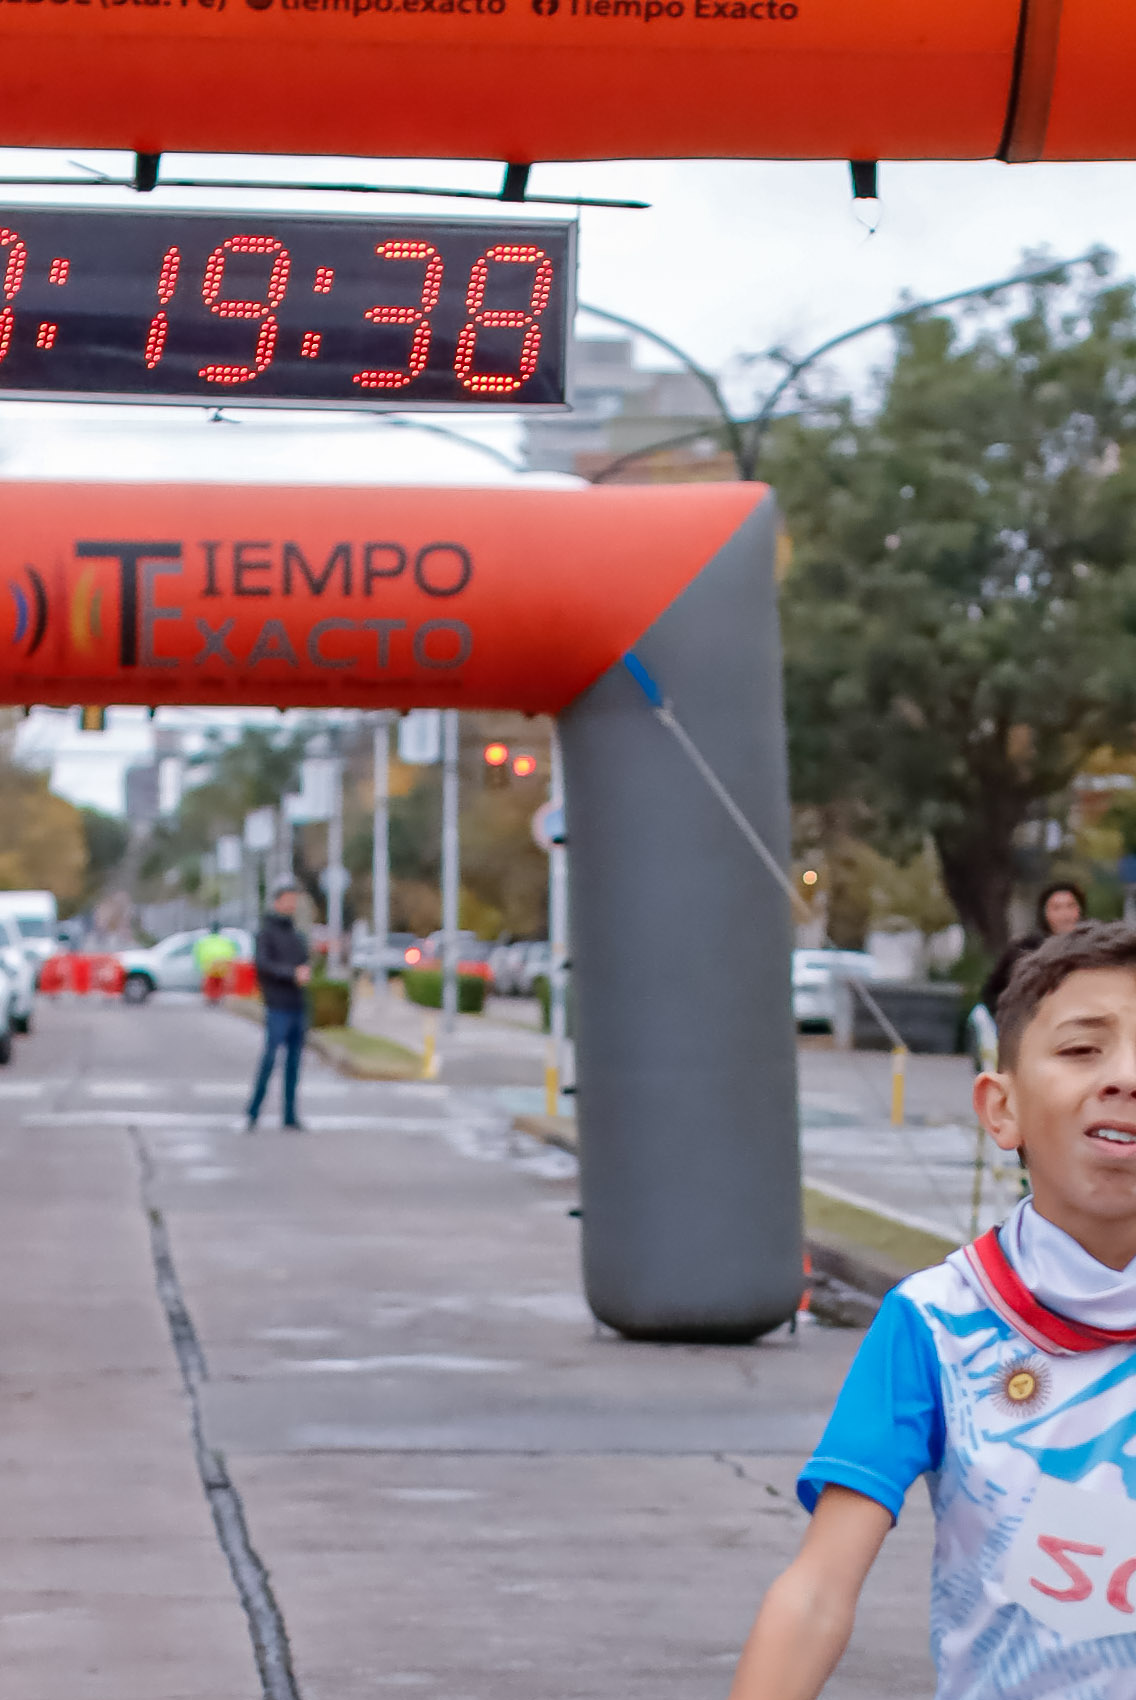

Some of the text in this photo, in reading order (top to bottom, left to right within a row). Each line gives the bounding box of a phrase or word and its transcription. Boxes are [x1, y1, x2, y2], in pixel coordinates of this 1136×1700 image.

[571, 0, 685, 22] Tiempo
[695, 0, 799, 20] Exacto
[0, 228, 553, 394] :19:38
